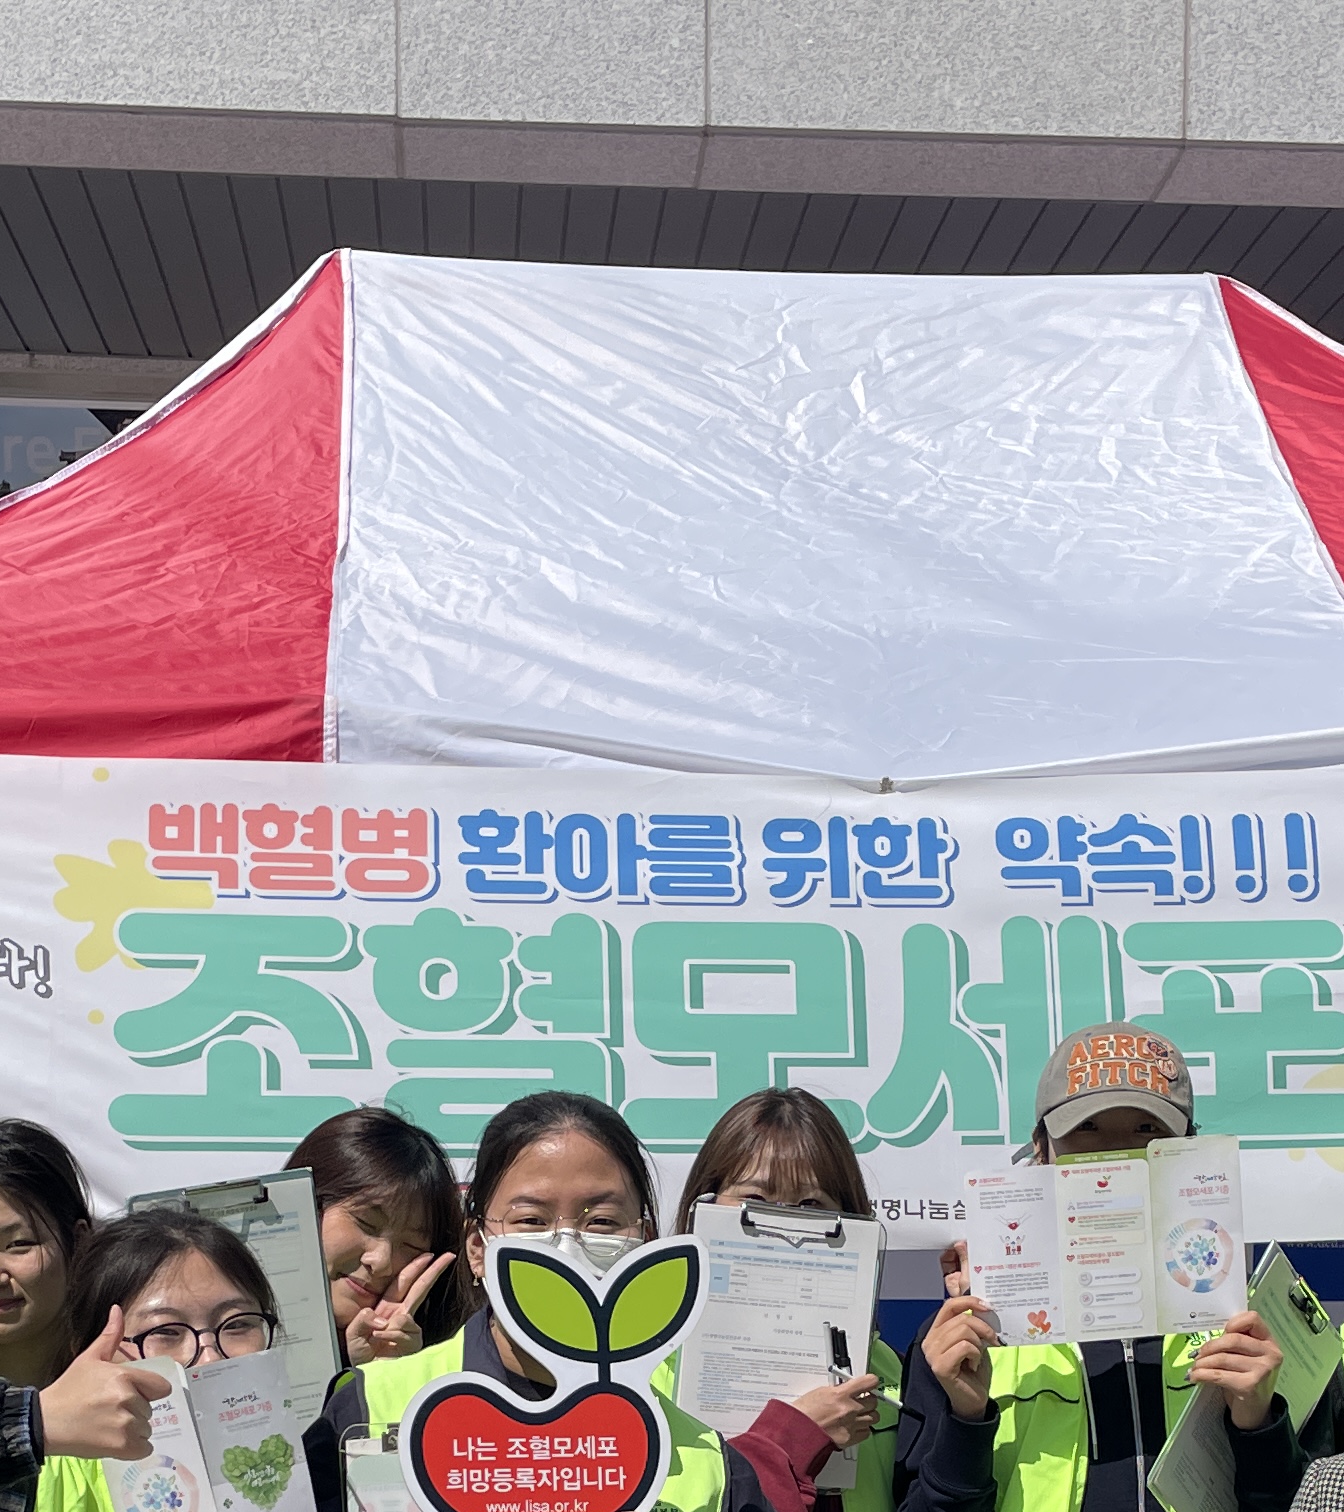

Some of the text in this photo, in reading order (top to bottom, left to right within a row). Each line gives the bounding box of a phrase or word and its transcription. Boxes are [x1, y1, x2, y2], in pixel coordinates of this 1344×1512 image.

[148, 801, 438, 900] 백혈병
[457, 808, 746, 904] 환아를
[762, 814, 958, 907] 위한
[452, 1435, 620, 1461] 나는 조혈모세포
[446, 1466, 627, 1493] 희망등록자입니다
